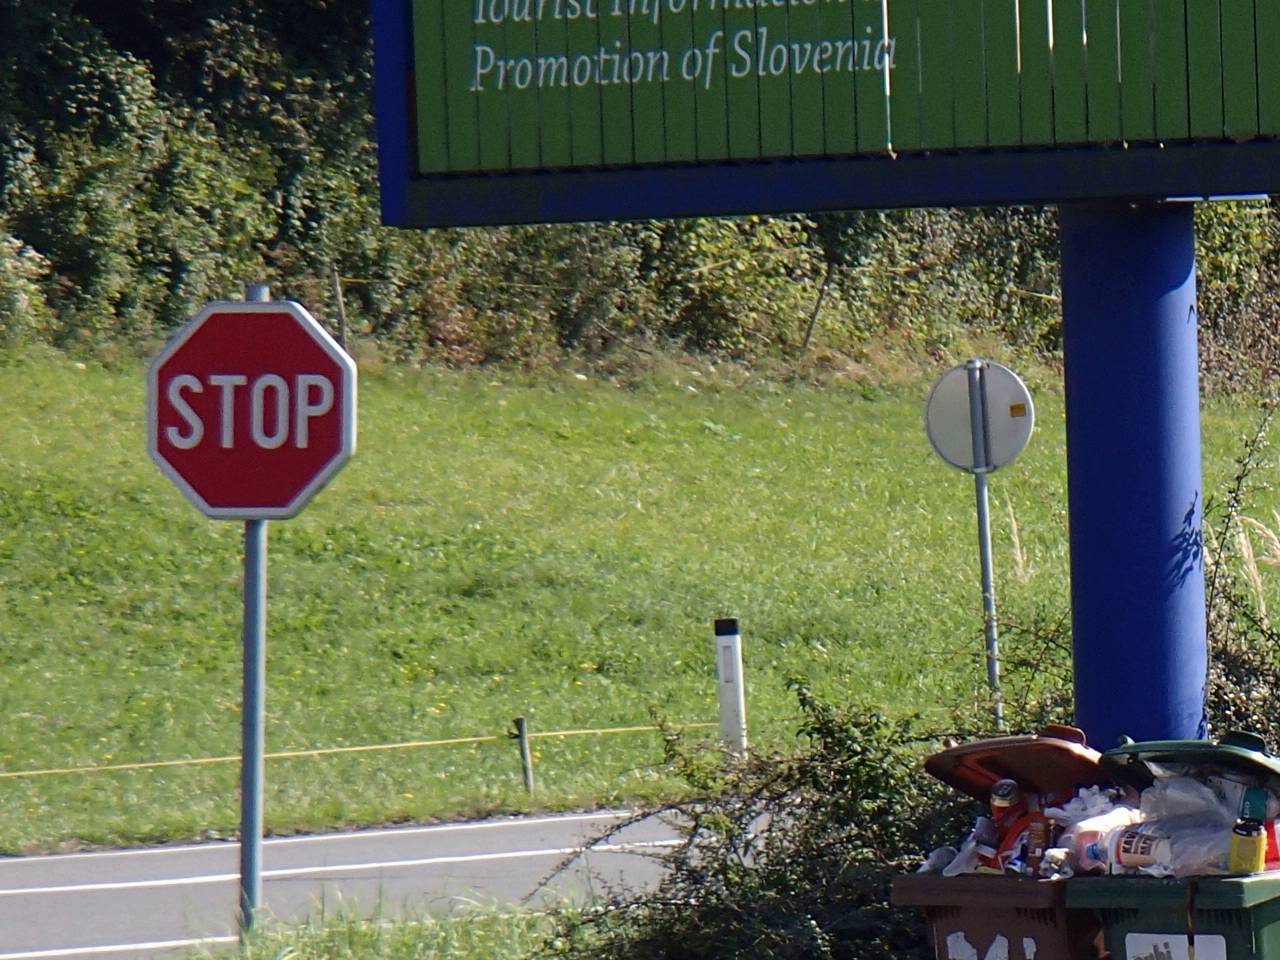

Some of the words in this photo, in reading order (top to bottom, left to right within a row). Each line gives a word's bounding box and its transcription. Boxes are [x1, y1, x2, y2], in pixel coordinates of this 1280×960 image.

[470, 40, 670, 91] Promotion
[682, 30, 724, 90] of
[731, 26, 897, 78] Slovenia
[166, 373, 335, 449] STOP
